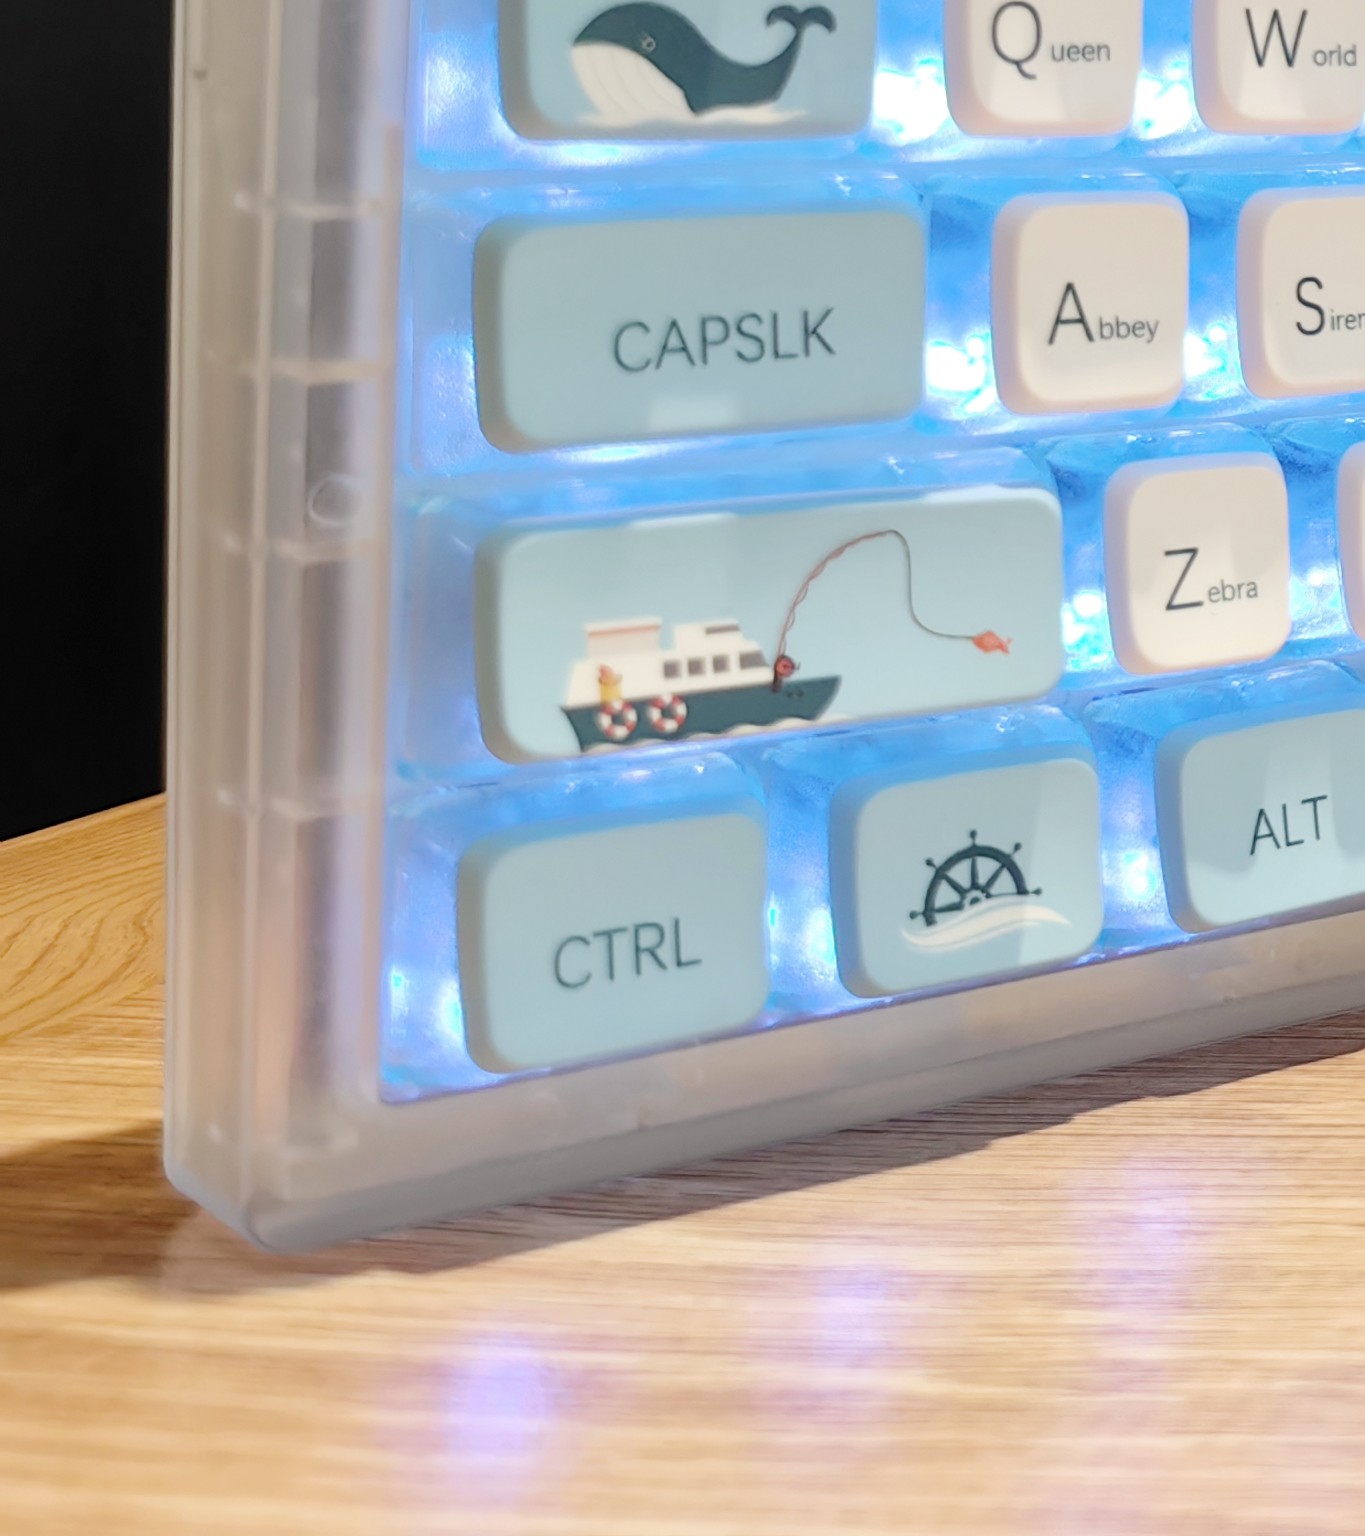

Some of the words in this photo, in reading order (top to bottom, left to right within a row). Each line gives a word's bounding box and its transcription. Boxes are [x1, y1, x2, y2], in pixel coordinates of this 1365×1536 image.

[612, 308, 835, 373] CAPSLK
[1248, 794, 1328, 857] ALT
[552, 917, 702, 990] CTRL
